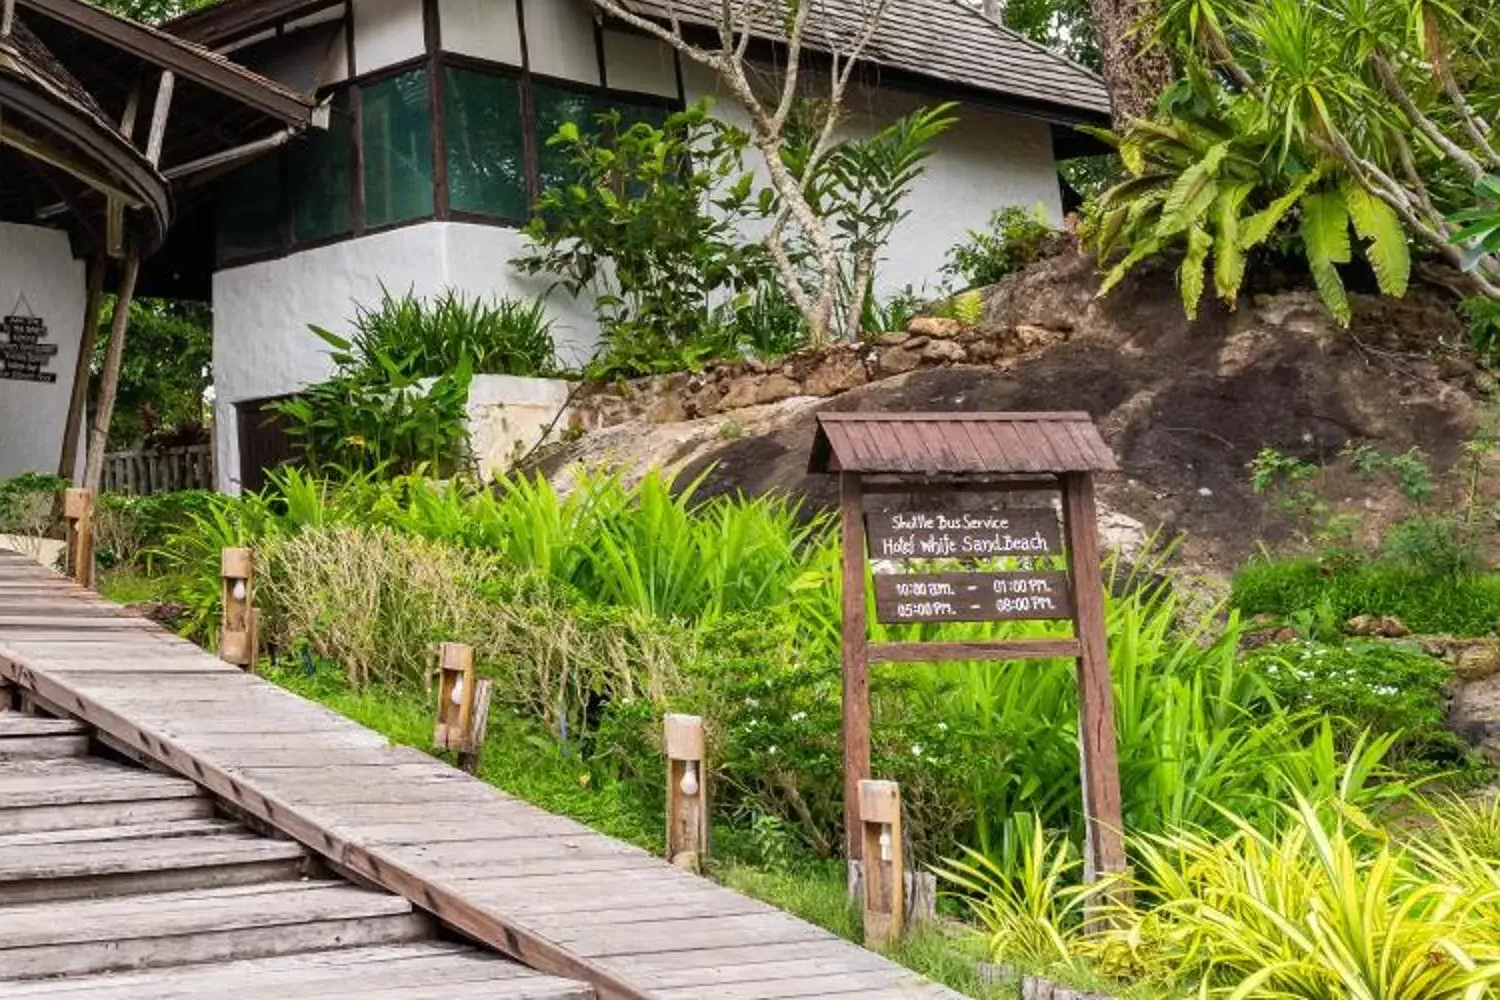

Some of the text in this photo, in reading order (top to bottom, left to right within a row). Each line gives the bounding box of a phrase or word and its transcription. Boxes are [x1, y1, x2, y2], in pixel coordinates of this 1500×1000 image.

[891, 514, 1009, 530] Shuttle Bus Service
[883, 534, 915, 555] Hotel
